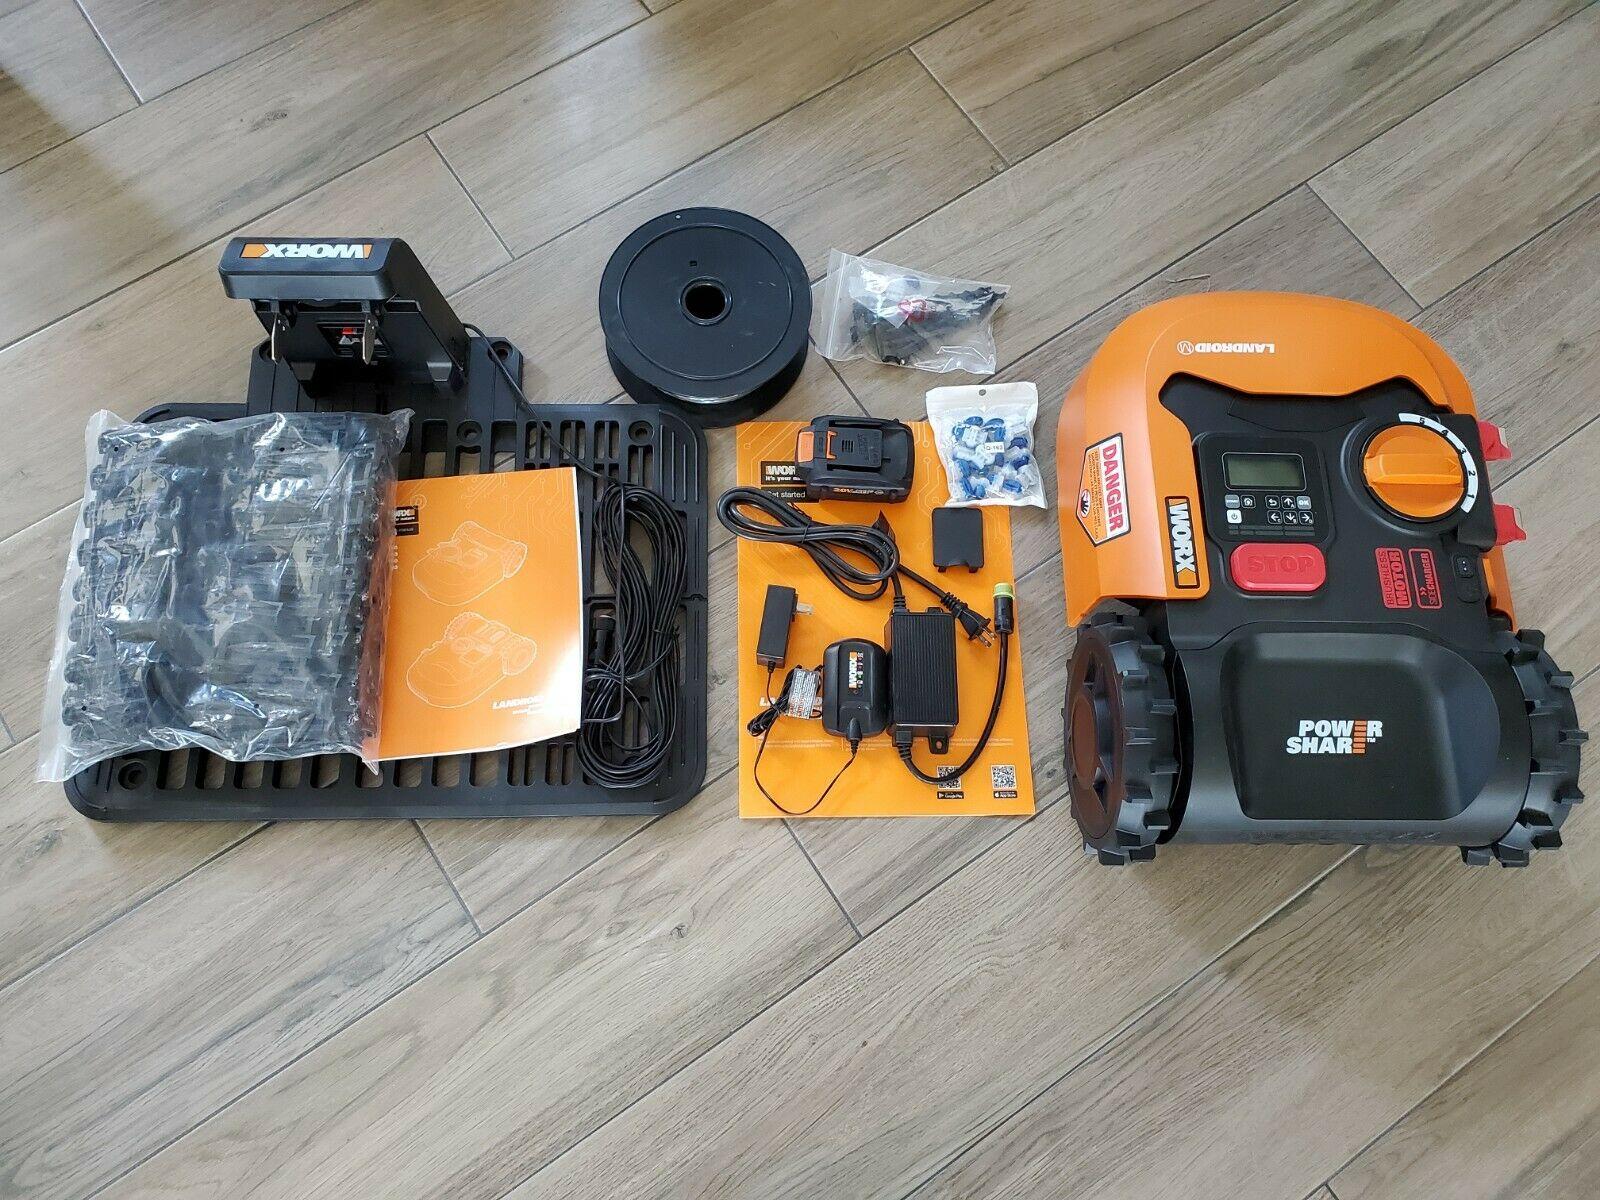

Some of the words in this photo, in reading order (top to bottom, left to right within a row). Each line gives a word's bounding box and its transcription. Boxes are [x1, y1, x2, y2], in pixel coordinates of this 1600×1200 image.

[260, 244, 364, 258] WORX
[1195, 342, 1275, 354] LANDROID
[1419, 417, 1425, 425] 5
[769, 466, 796, 475] WOR
[1102, 443, 1124, 532] DANGER
[1169, 502, 1196, 573] WORX
[1247, 555, 1315, 574] STOP
[1378, 551, 1396, 606] BRUSHLESS
[1388, 551, 1410, 606] MOTOR
[1299, 719, 1383, 737] POWER
[1286, 736, 1366, 754] SHARE
